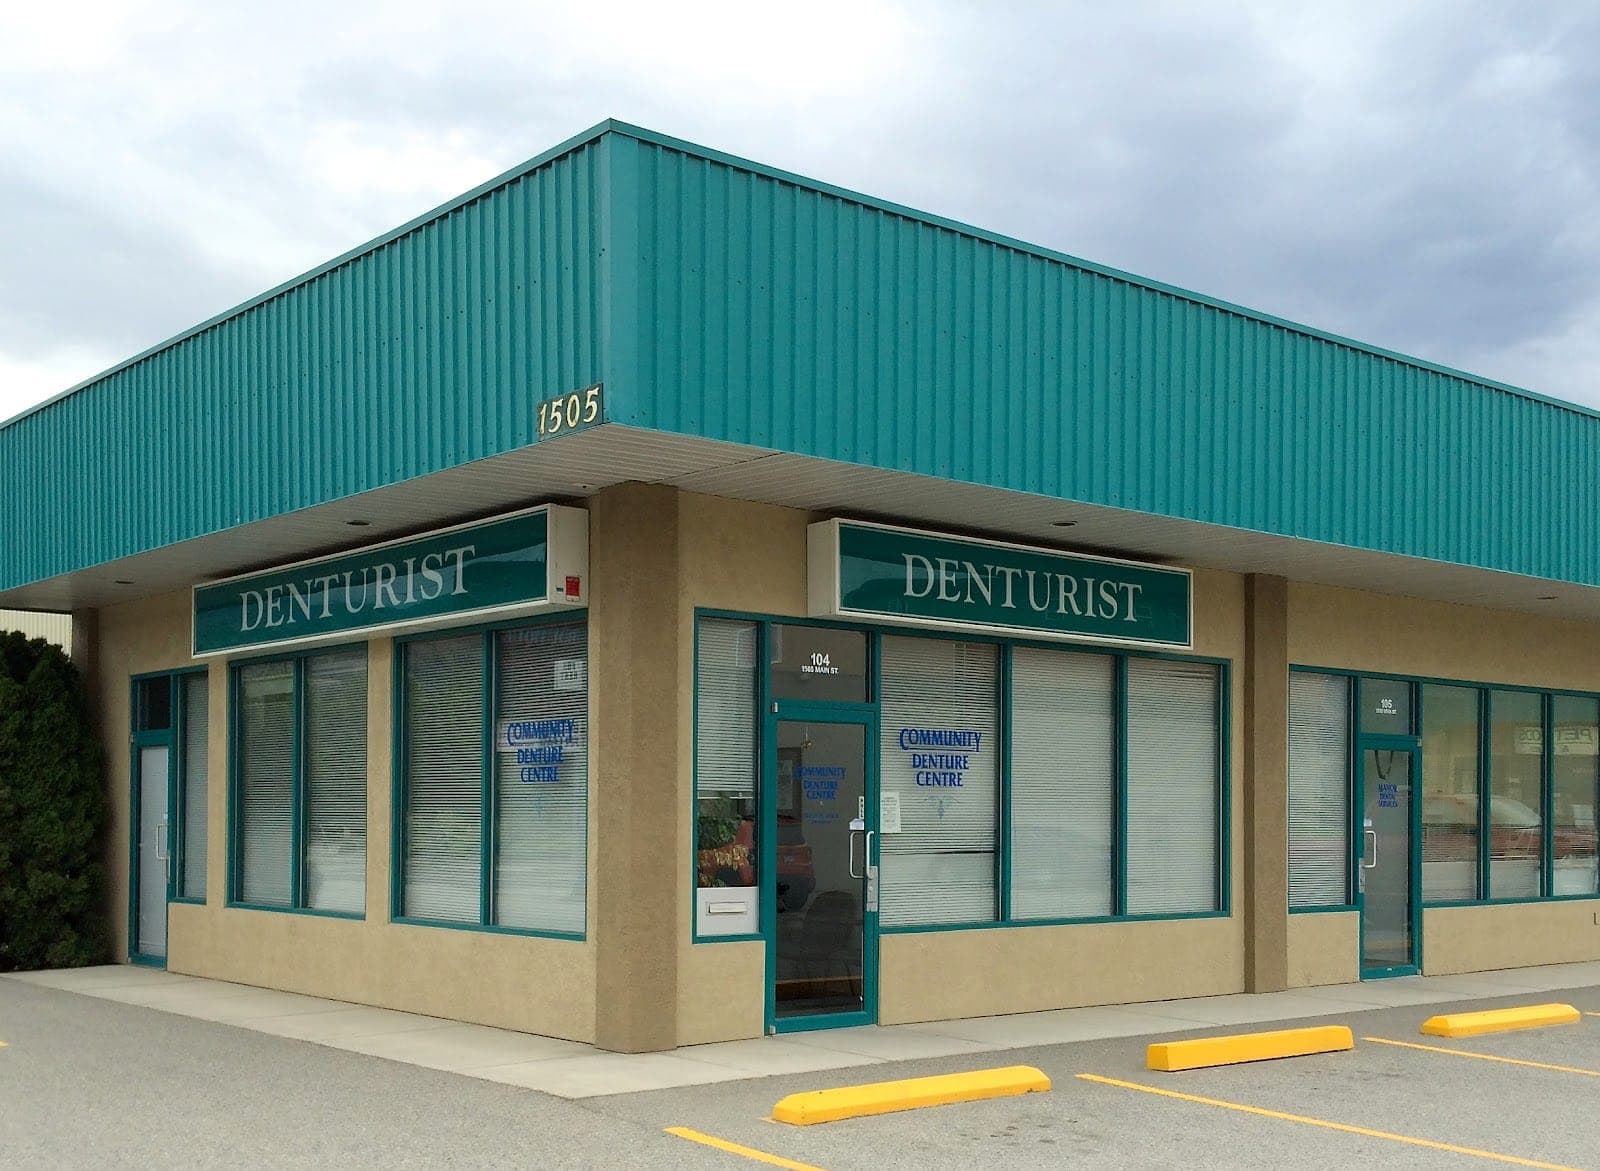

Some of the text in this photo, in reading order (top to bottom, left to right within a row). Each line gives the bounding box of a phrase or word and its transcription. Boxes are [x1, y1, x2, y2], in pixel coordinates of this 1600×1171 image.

[539, 387, 600, 435] 1505
[239, 544, 476, 632] DENTURIST
[902, 552, 1143, 622] DENTURIST
[810, 652, 831, 666] 104
[814, 665, 830, 674] MAIN
[507, 719, 575, 746] COMMUNITY
[899, 728, 981, 753] COMMUNITY
[517, 746, 563, 764] DENTURE
[912, 753, 969, 770] DENTURE
[520, 766, 559, 782] CENTRE
[797, 766, 846, 781] COMMUNITY
[916, 771, 963, 787] CENTRE
[804, 780, 838, 790] DENTURE
[806, 790, 836, 800] CENTRE
